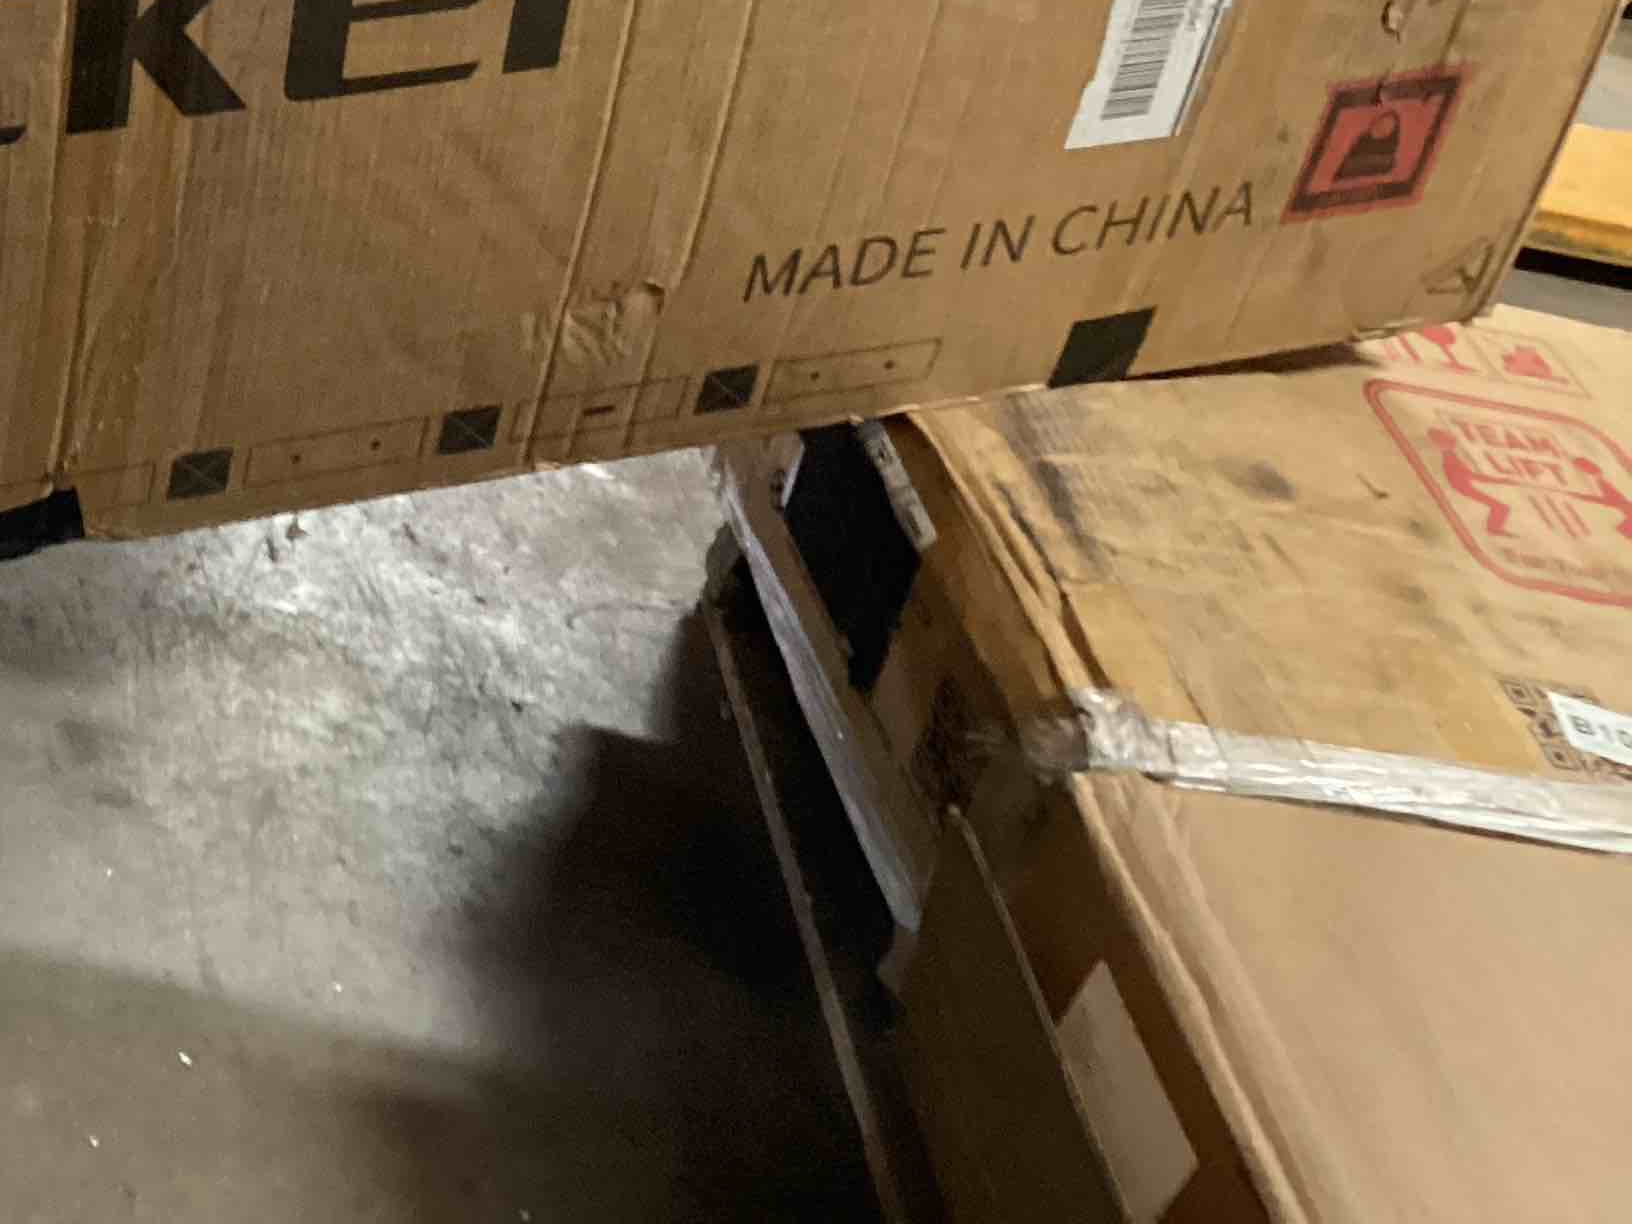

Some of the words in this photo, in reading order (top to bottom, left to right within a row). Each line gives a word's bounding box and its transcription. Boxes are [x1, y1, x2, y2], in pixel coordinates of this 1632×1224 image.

[742, 227, 946, 303] MADE
[959, 214, 1036, 272] IN
[1051, 180, 1254, 257] CHINA
[1450, 417, 1564, 458] TEAM
